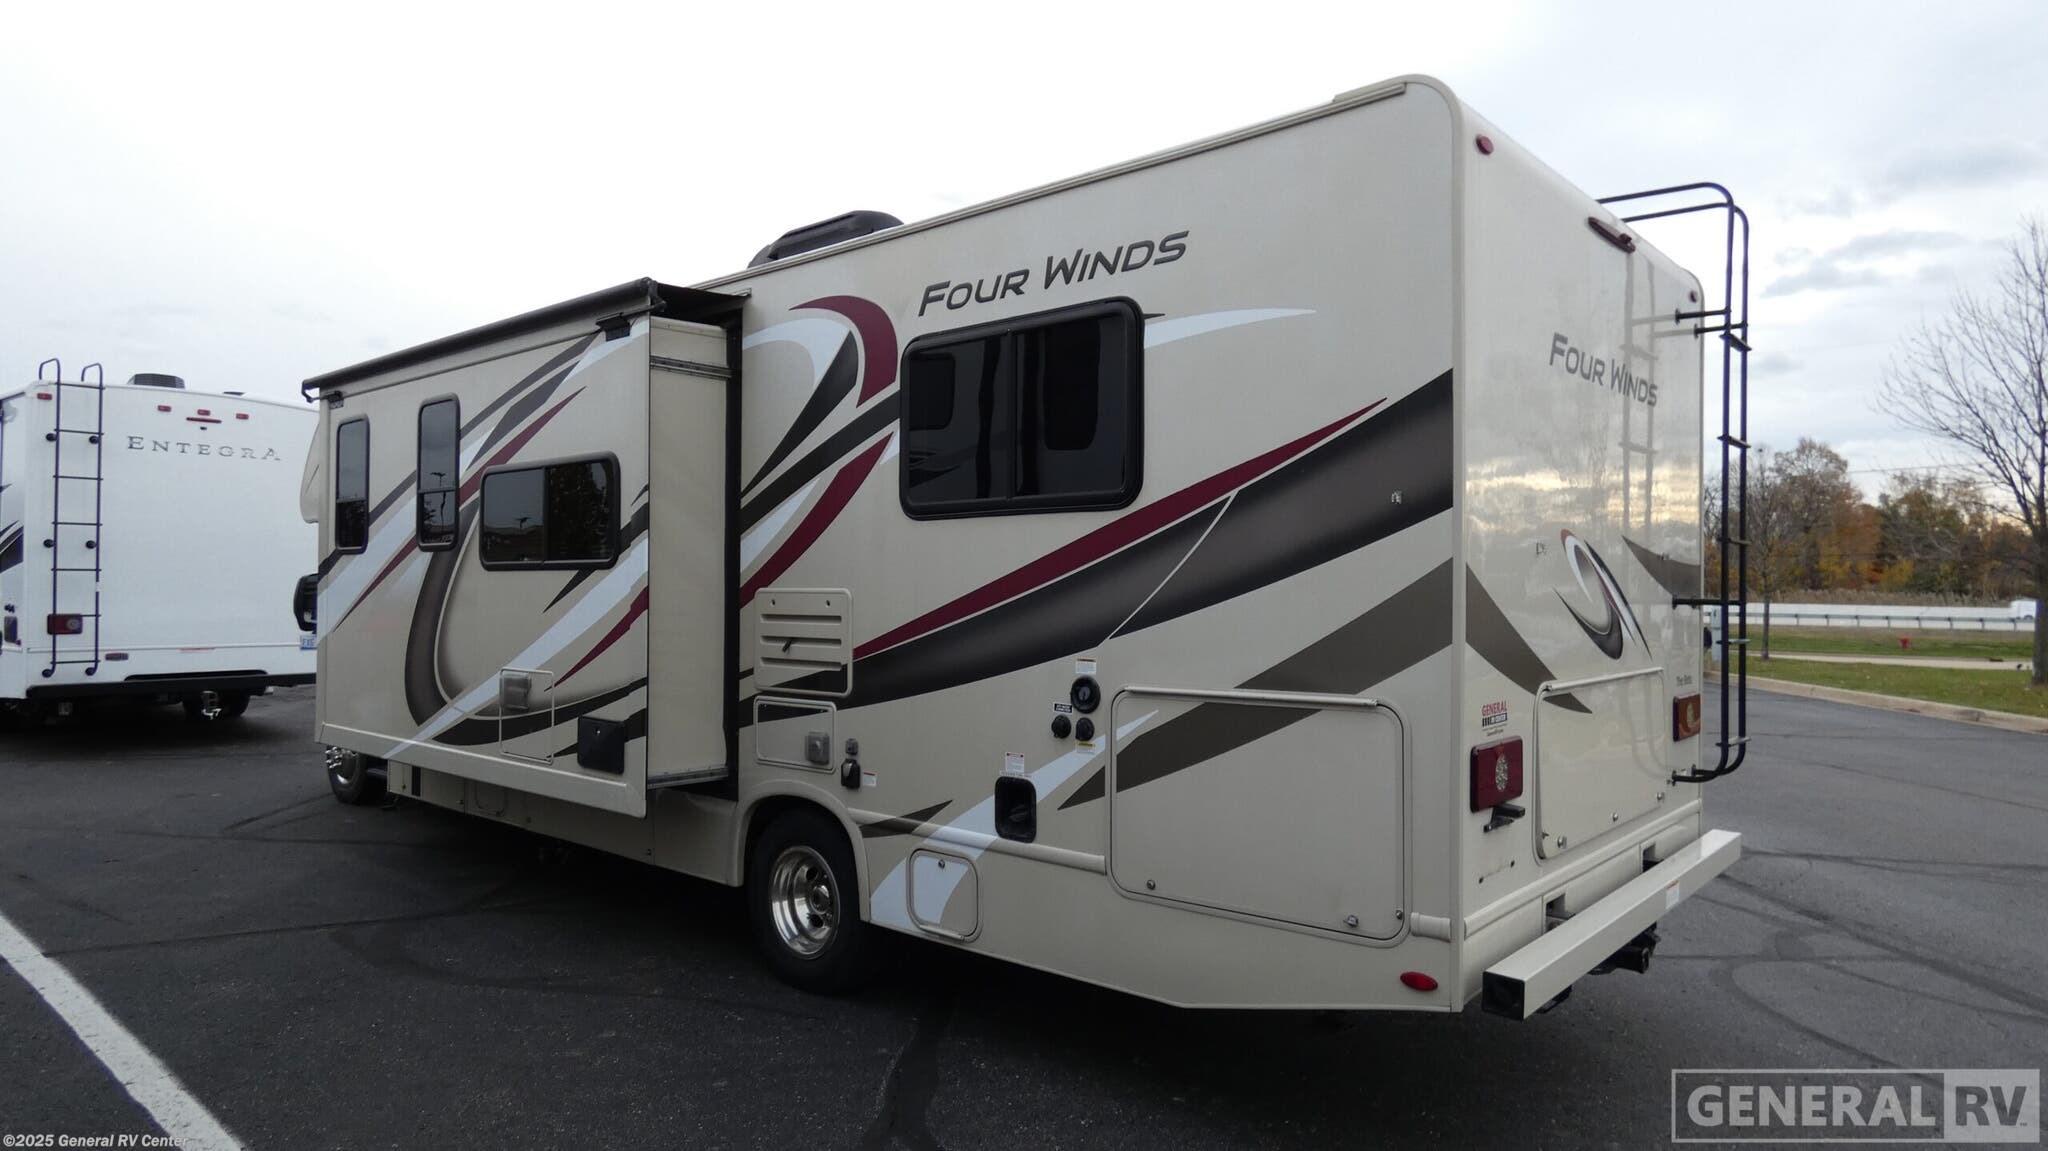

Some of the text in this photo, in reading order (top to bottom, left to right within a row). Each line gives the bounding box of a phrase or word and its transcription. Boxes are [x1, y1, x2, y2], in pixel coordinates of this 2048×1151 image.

[918, 230, 1190, 317] FOUR WINDS
[1549, 332, 1658, 407] FOUR WINDS
[127, 435, 282, 461] ENTEGRA
[1481, 700, 1508, 717] GENERAL
